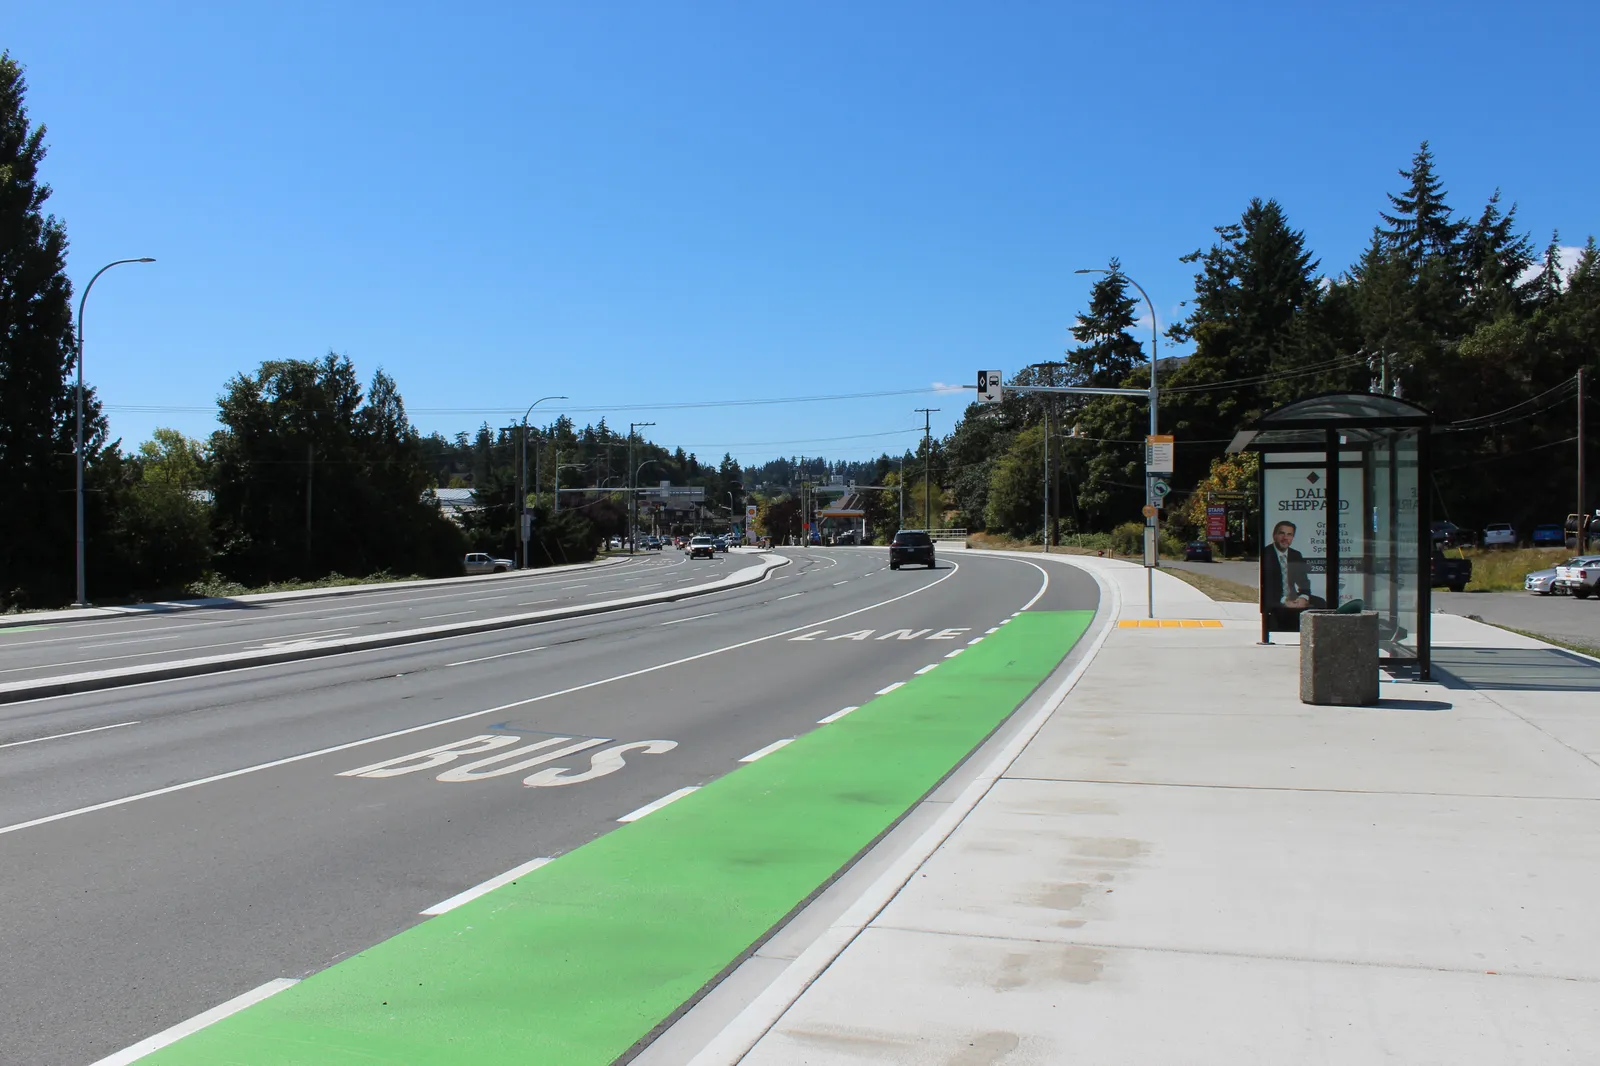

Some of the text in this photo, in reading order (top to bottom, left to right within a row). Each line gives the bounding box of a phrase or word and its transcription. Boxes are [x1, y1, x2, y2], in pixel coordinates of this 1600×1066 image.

[1278, 500, 1350, 511] SHEPPAD
[787, 627, 972, 641] LANE
[333, 734, 679, 788] BUS
